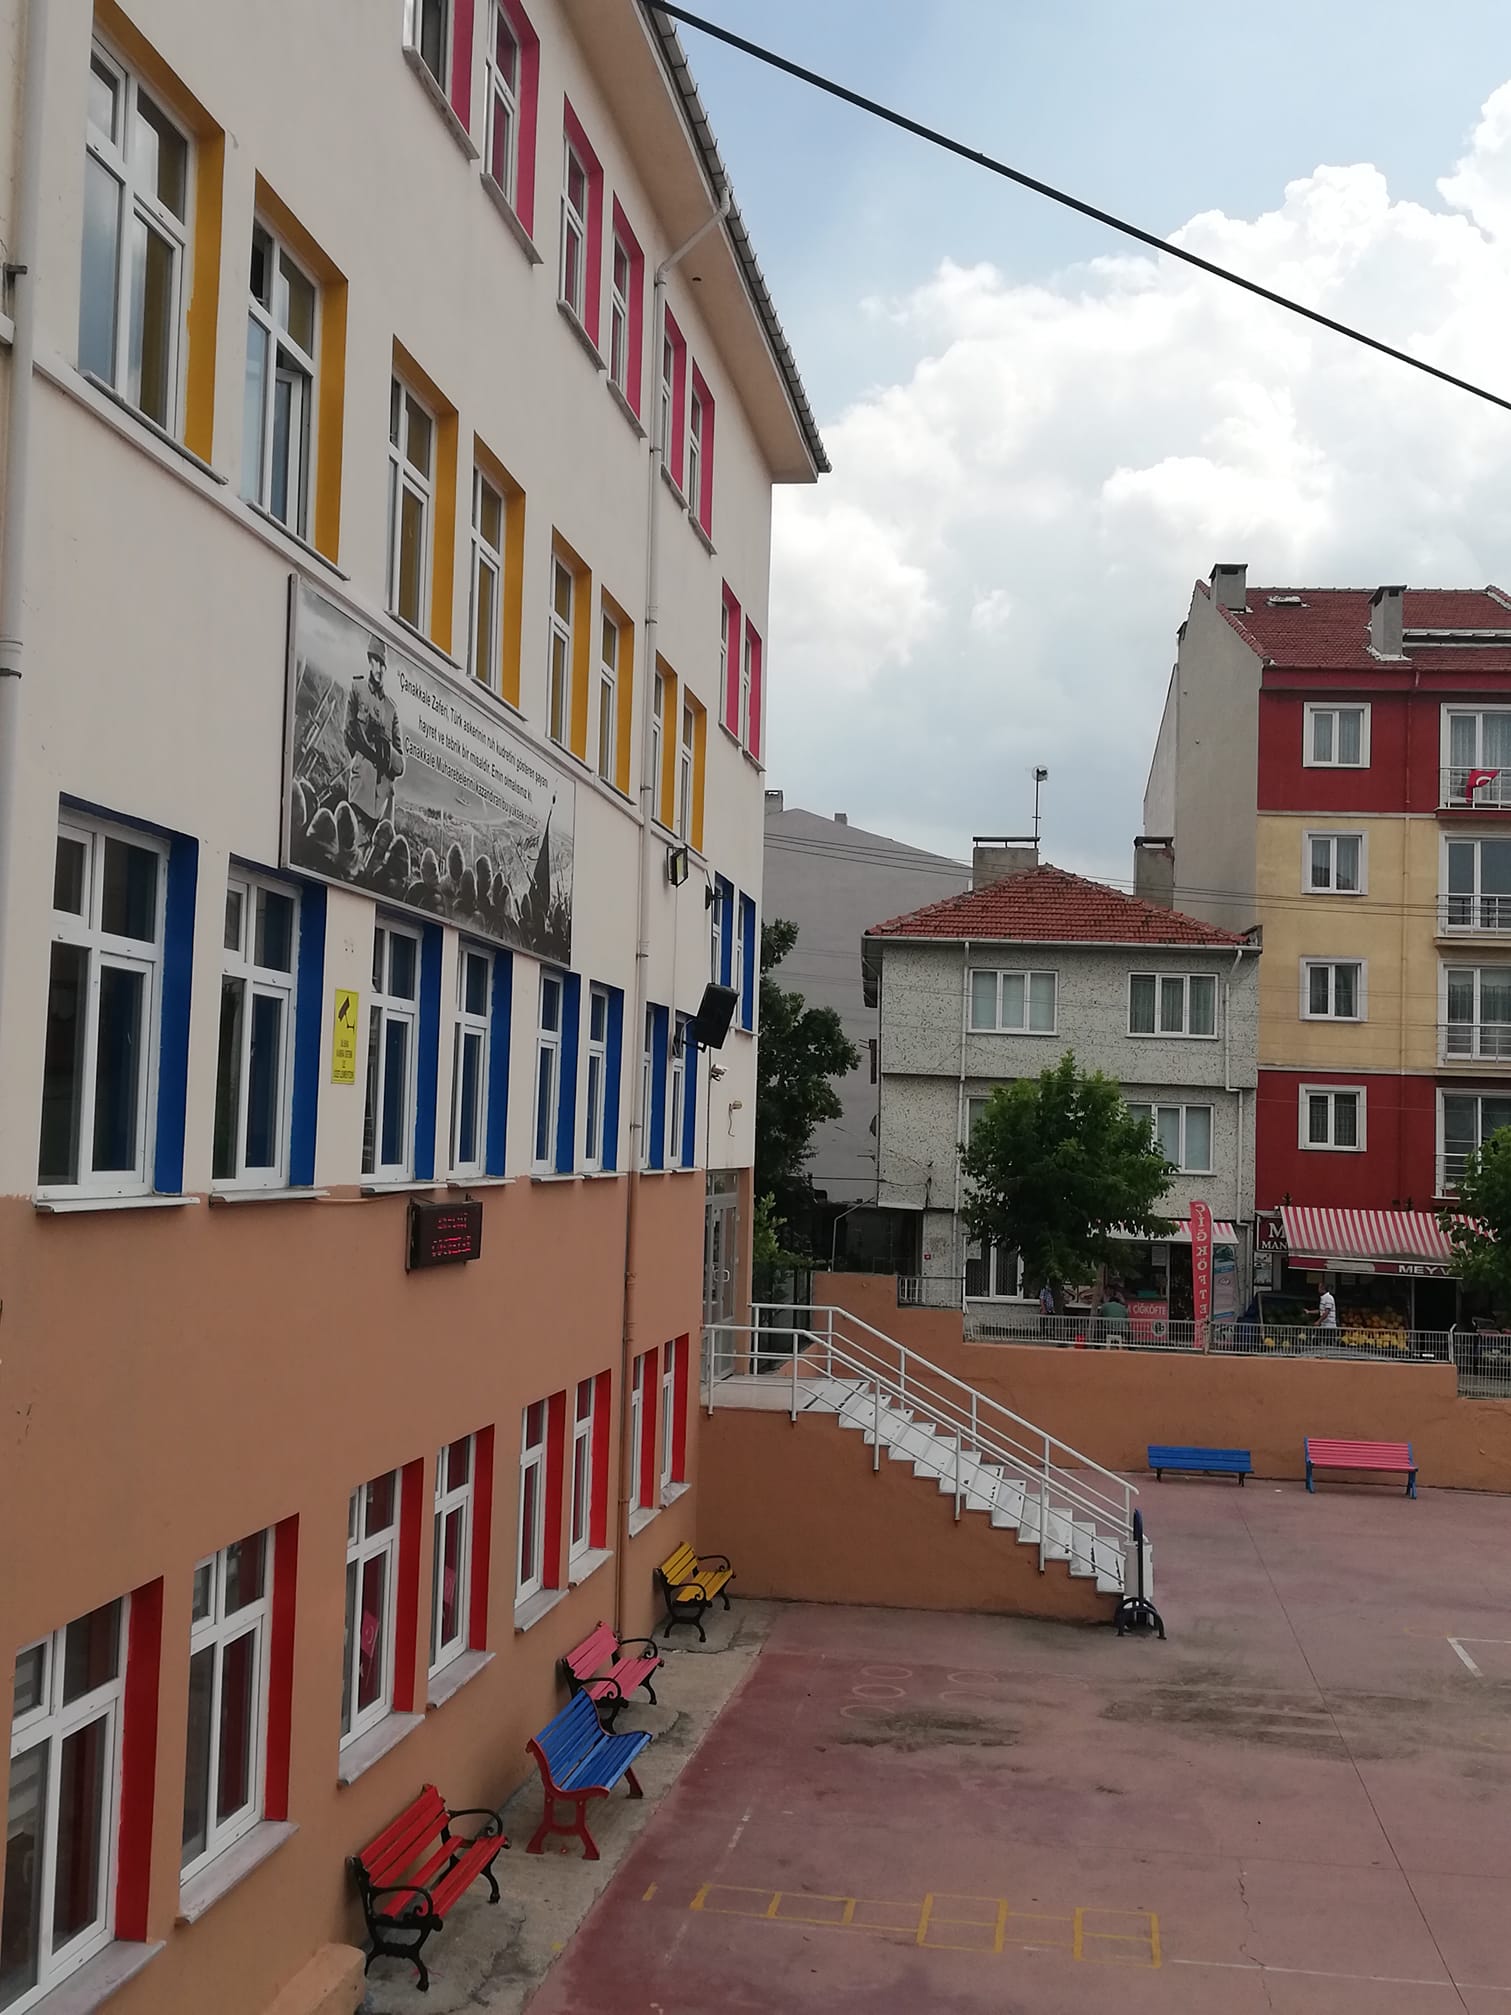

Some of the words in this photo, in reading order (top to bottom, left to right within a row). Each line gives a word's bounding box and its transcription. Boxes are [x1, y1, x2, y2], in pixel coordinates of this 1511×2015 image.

[450, 707, 463, 728] Türk
[418, 714, 437, 741] hayret
[438, 731, 445, 745] ve
[445, 734, 461, 755] tebrik
[461, 741, 469, 760] bir
[491, 763, 504, 784] Emin
